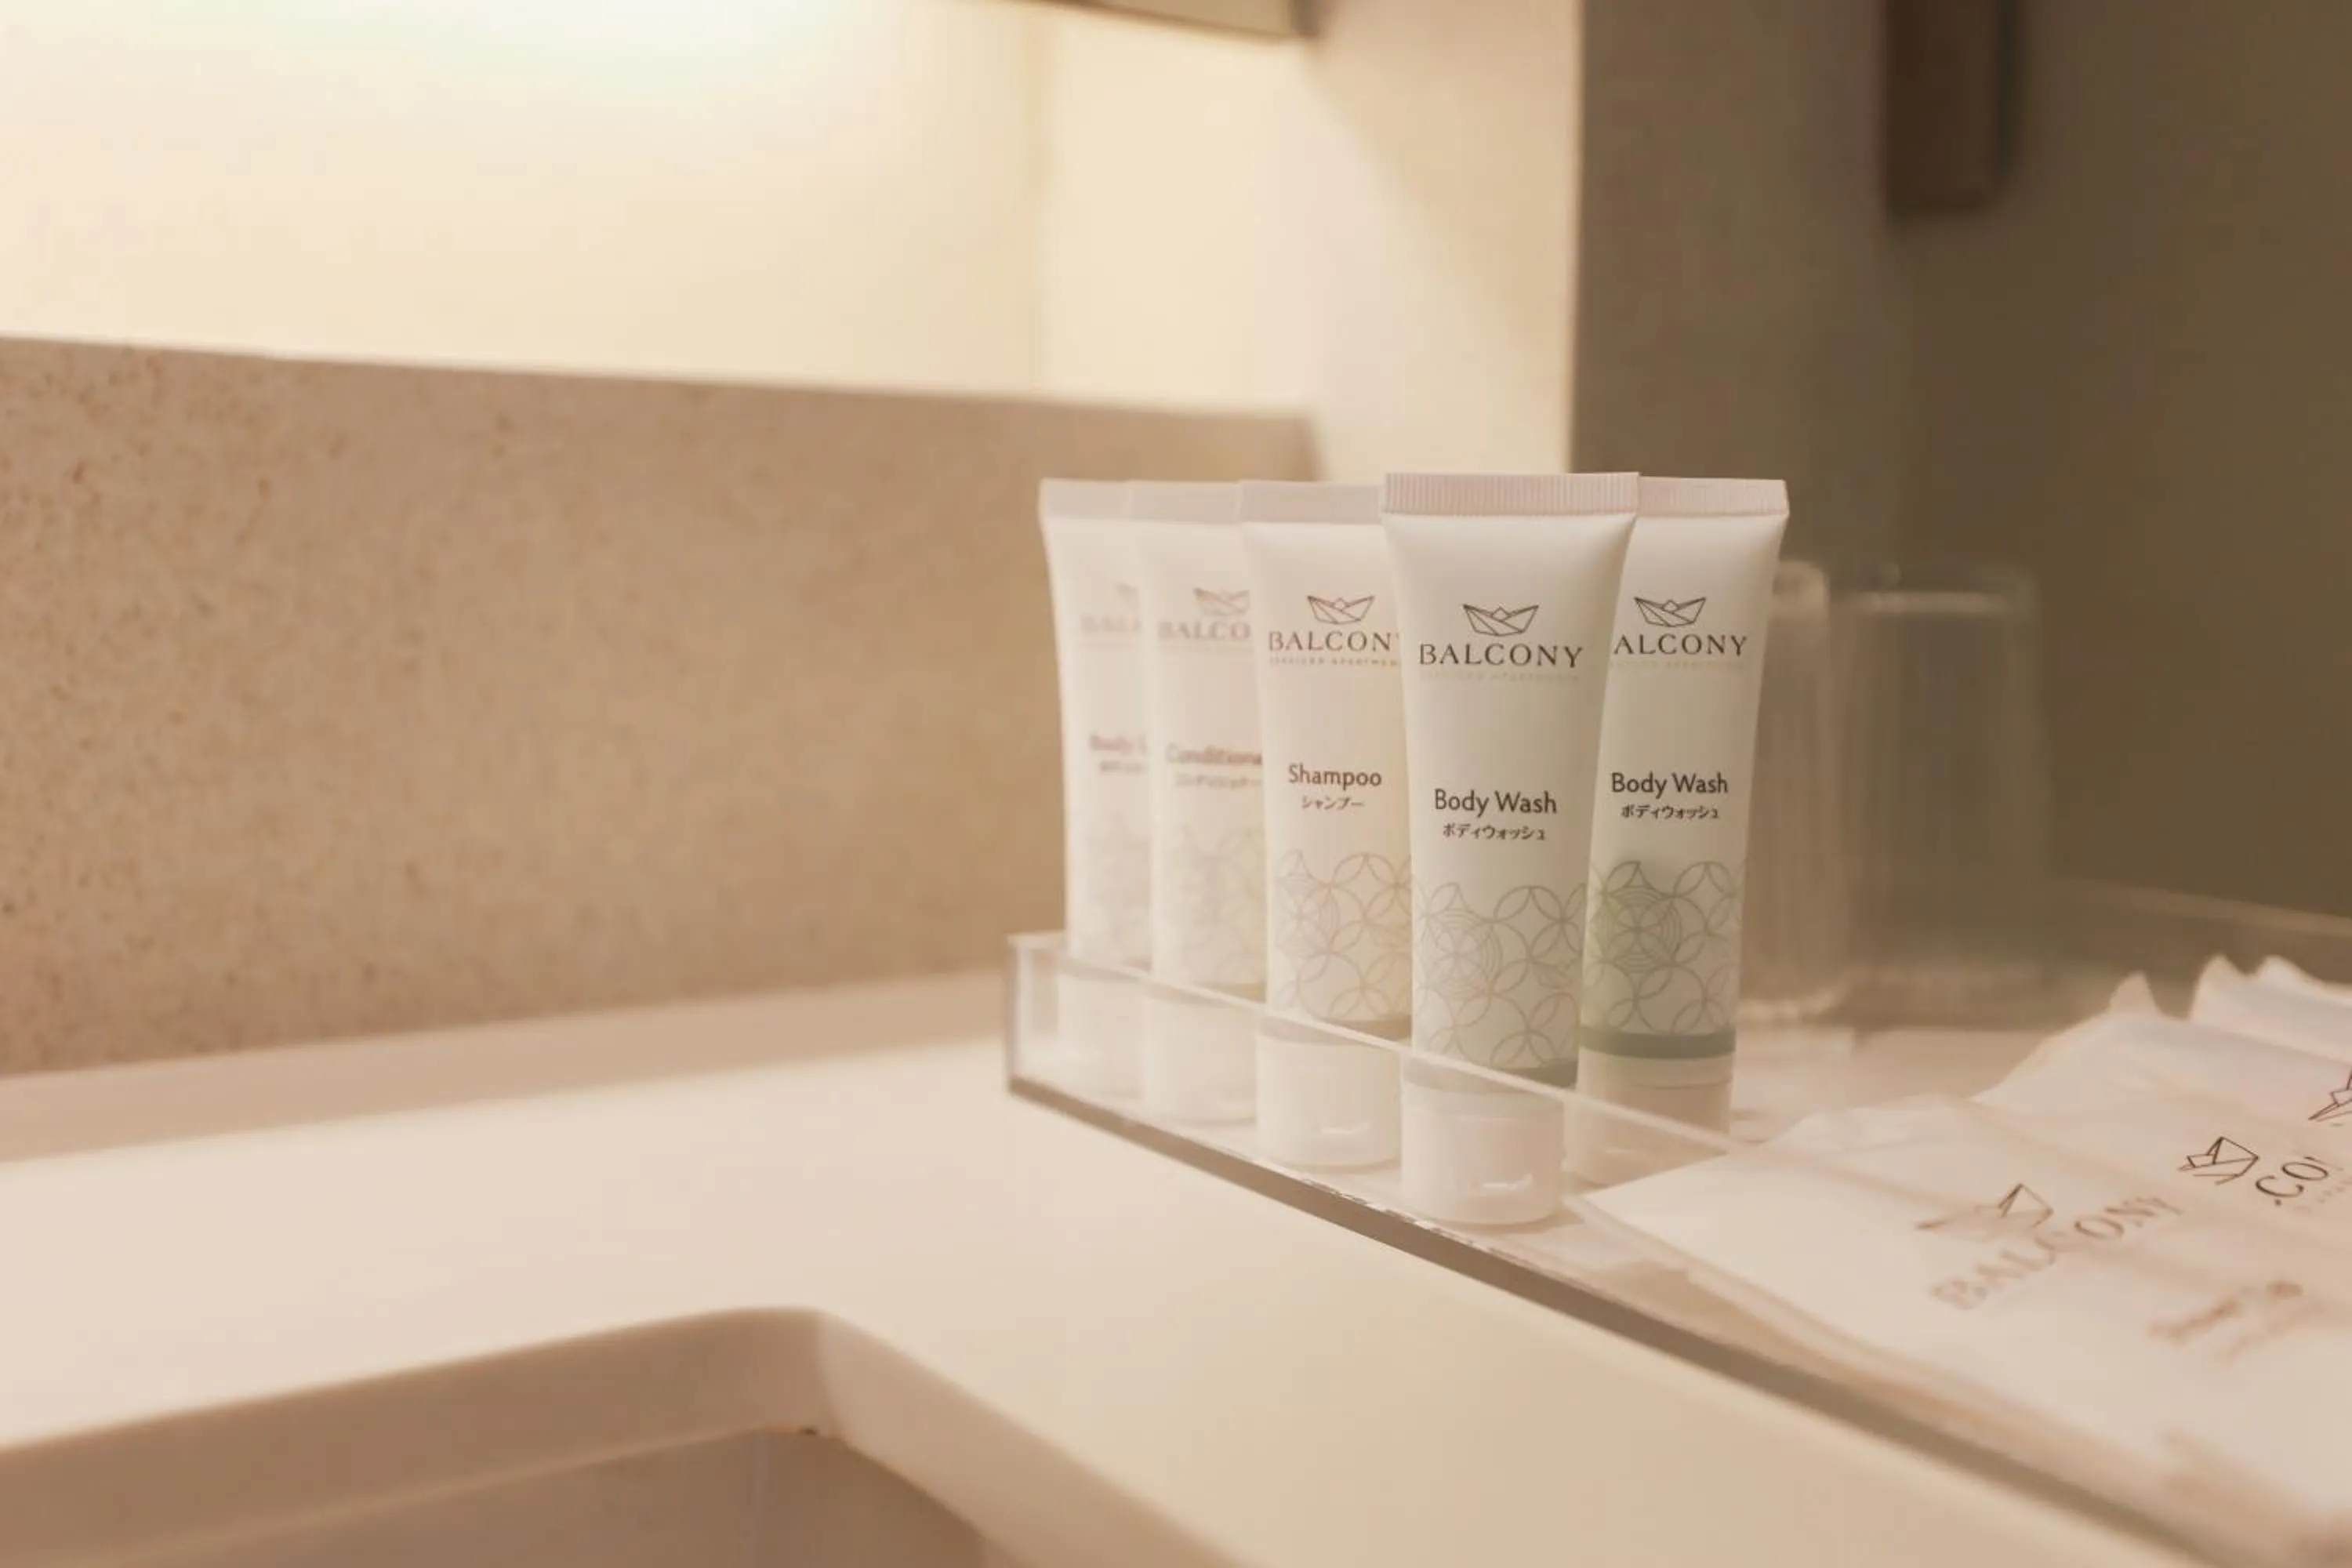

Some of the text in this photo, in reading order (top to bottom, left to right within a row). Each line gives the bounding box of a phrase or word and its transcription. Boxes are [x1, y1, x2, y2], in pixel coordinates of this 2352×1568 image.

[1158, 621, 1252, 641] BALCO
[1269, 630, 1399, 652] BALCON
[1419, 643, 1583, 668] BALCONY
[1613, 633, 1748, 656] ALCONY
[1288, 763, 1382, 790] Shampoo
[1611, 771, 1729, 800] Body Wash
[1301, 795, 1365, 811] シャンプー
[1435, 788, 1557, 818] Body Wash
[1443, 822, 1546, 840] ボディウォッシュ
